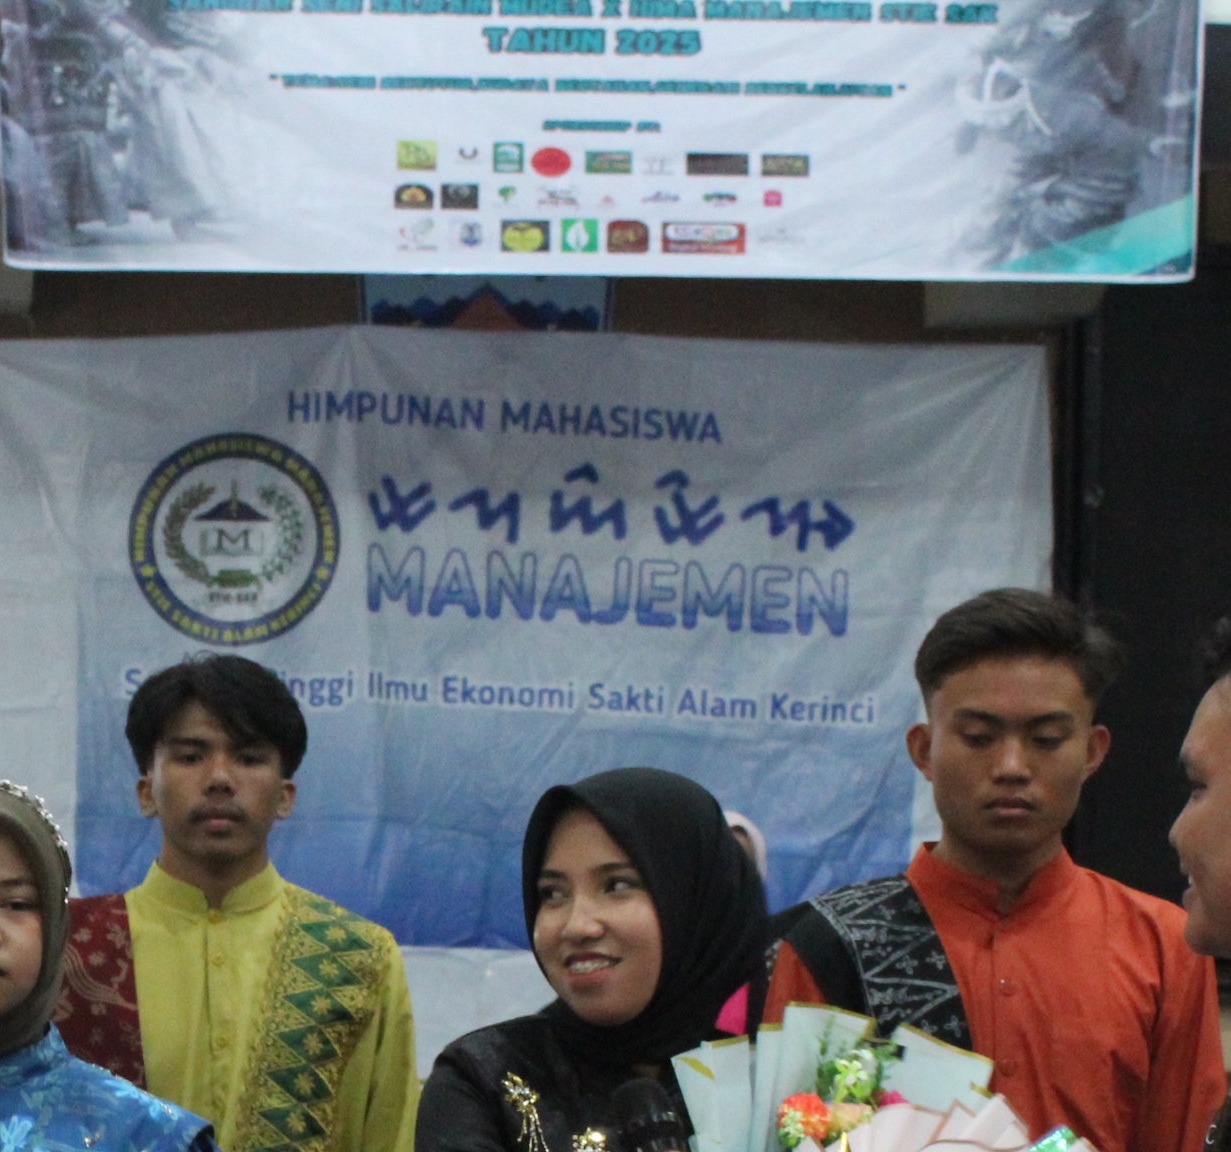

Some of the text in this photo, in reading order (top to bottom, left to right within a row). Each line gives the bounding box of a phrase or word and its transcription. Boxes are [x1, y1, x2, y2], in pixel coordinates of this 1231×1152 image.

[601, 0, 622, 17] X
[703, 1, 872, 21] MANAJEMEN
[482, 27, 702, 55] TAHUN 2025
[287, 390, 723, 444] HIMPUNAN MAHASISWA
[367, 543, 849, 637] MANAJEMEN
[274, 669, 875, 723] nggi Ilmu Ekonomi Sakti Alam Kerinci
